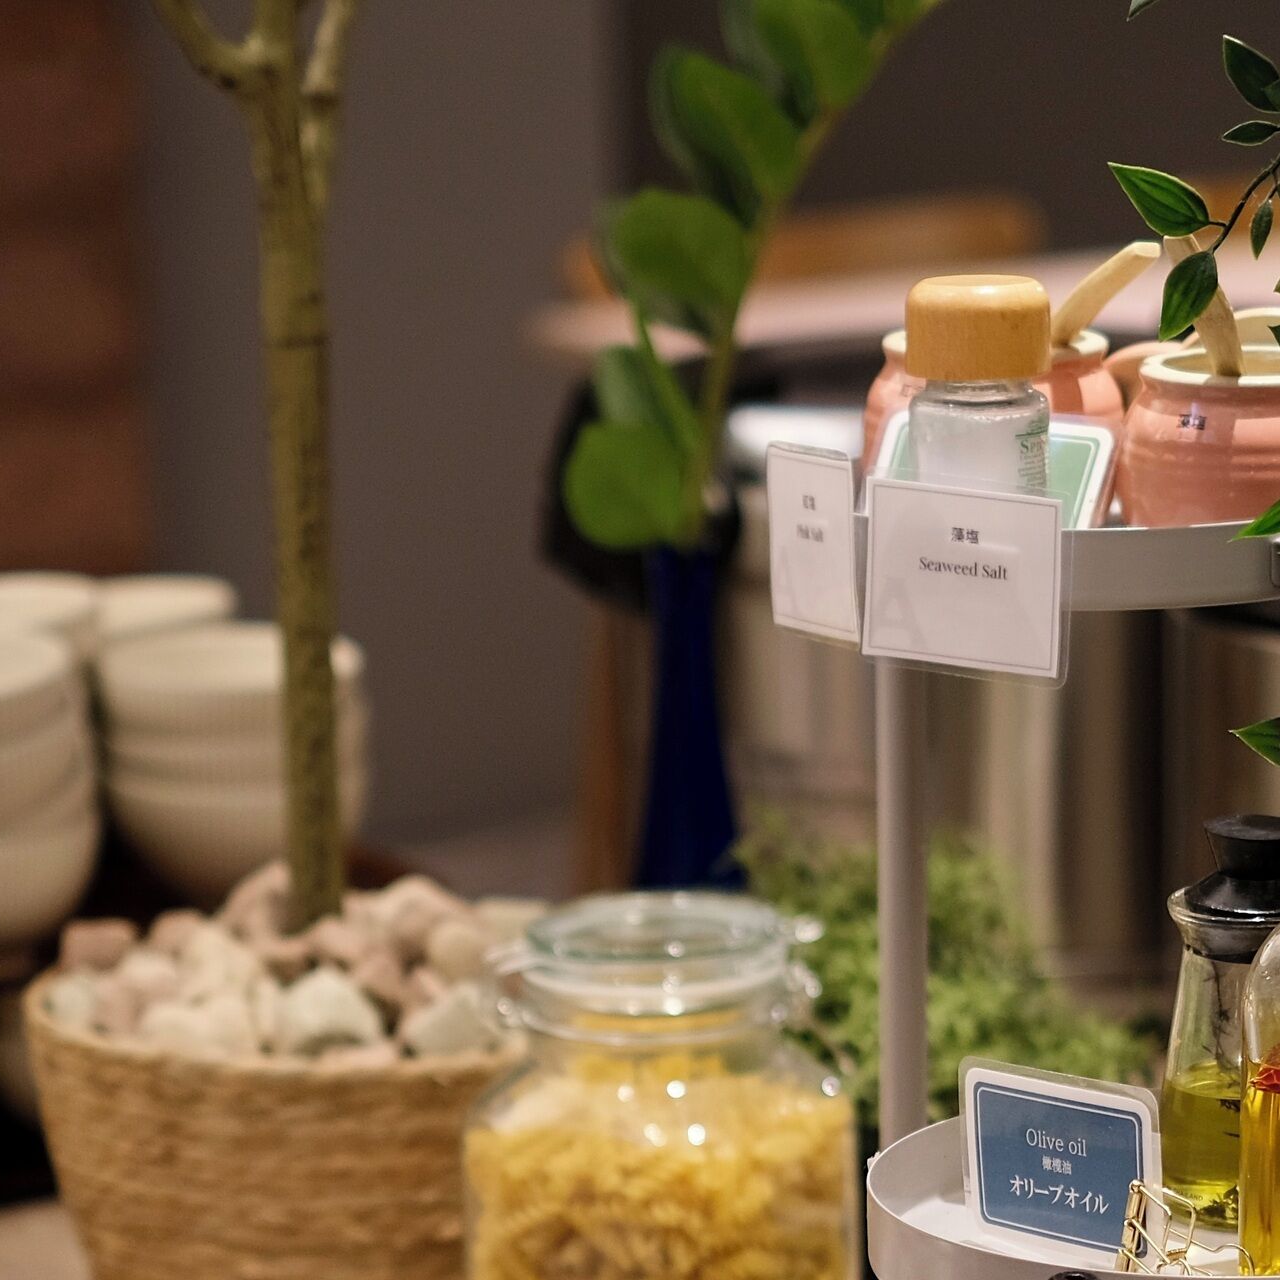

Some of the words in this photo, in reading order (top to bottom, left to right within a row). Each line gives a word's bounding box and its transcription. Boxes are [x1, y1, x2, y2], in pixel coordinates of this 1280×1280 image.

[919, 556, 979, 577] Seaweed
[981, 563, 1008, 581] Salt
[1025, 1128, 1065, 1152] Olive
[1068, 1137, 1087, 1157] oil
[1009, 1174, 1110, 1215] オリーブオイル
